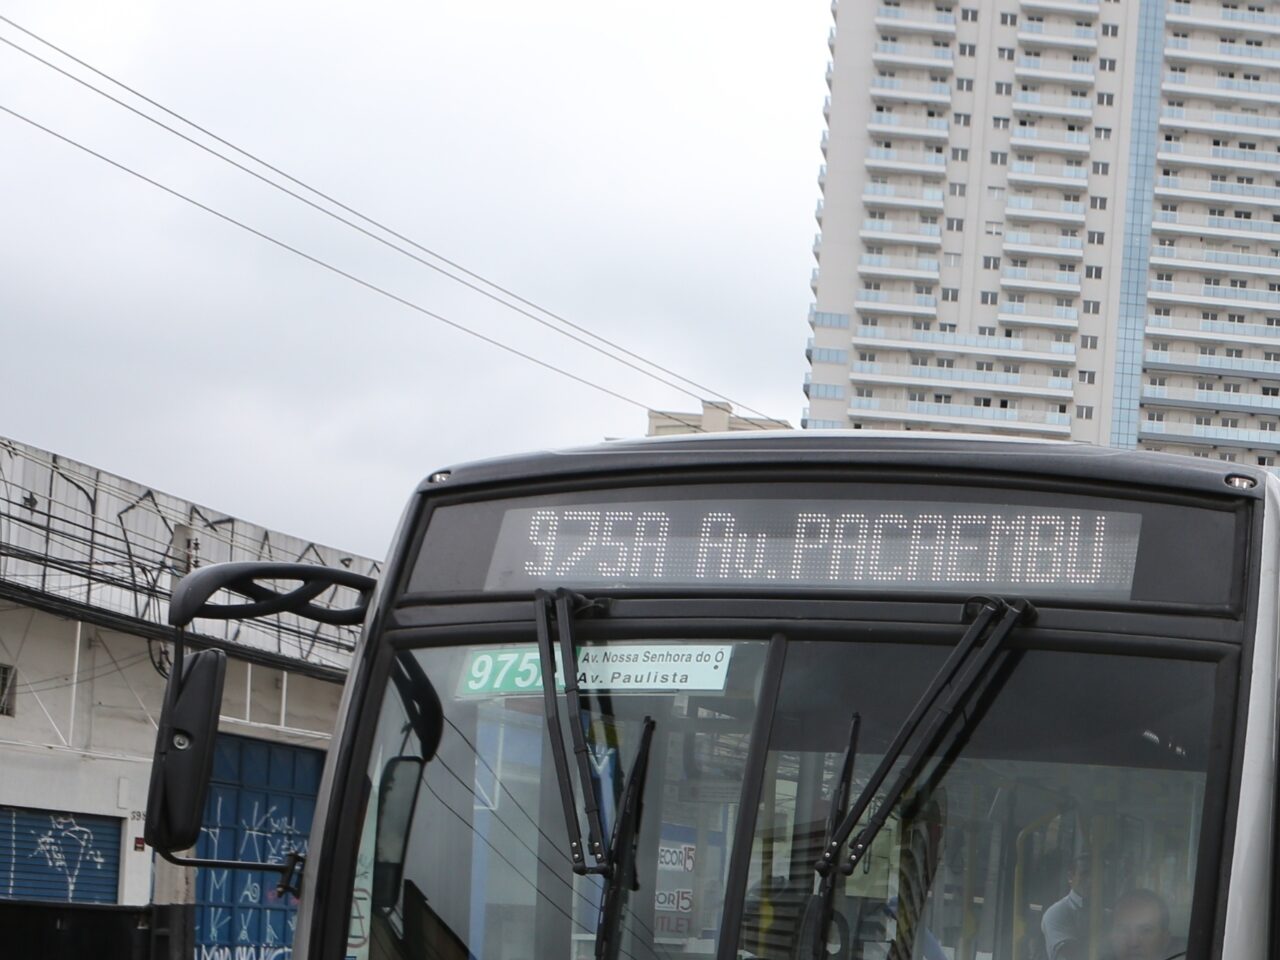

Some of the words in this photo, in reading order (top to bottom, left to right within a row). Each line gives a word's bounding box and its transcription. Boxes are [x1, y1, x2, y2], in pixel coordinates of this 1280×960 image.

[525, 511, 669, 577] 975A
[696, 512, 775, 578] Av.
[791, 513, 1105, 583] PACAEMBU
[602, 651, 639, 662] Nossa
[642, 650, 692, 662] Senhora
[696, 650, 711, 662] do
[610, 671, 690, 683] Paulista
